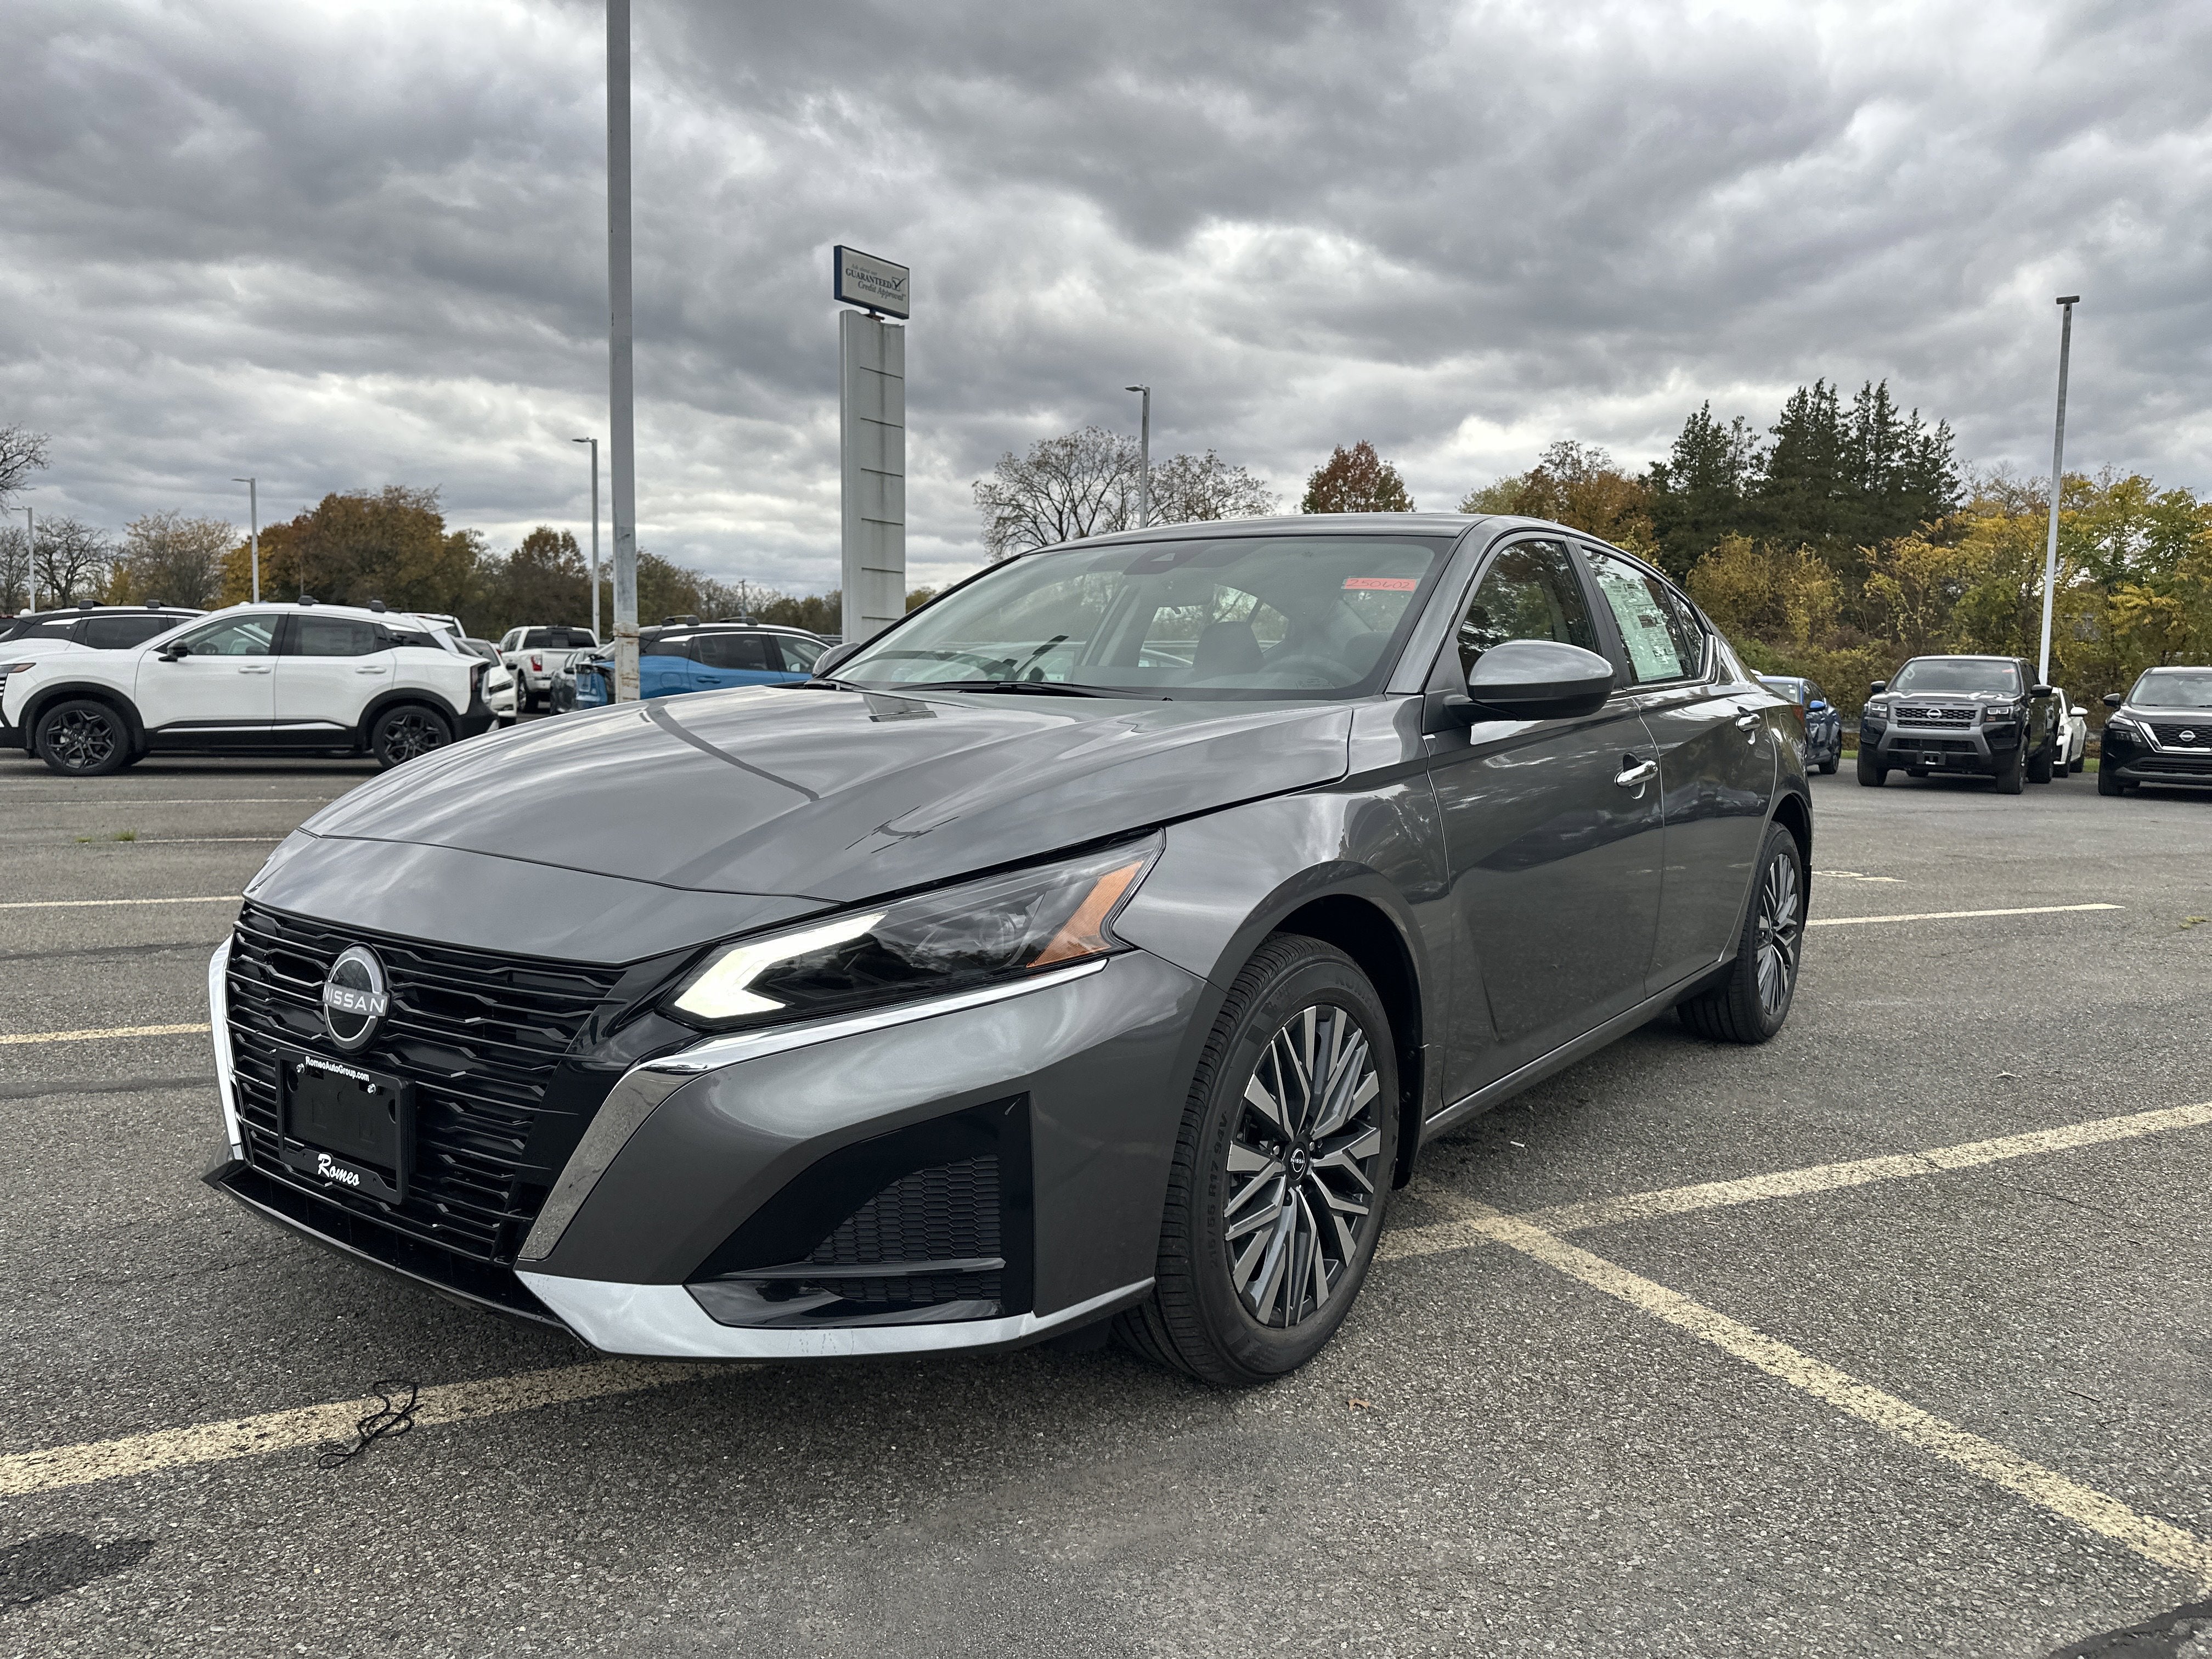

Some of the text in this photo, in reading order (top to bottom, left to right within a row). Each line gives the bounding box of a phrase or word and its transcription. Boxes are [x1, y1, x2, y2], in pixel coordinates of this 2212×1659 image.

[845, 268, 891, 289] GUARANTEED
[858, 280, 876, 292] Credit
[323, 985, 385, 1013] NISSAN
[305, 1056, 369, 1081] RomeoAutoGroup.com
[318, 1153, 360, 1186] Romeo
